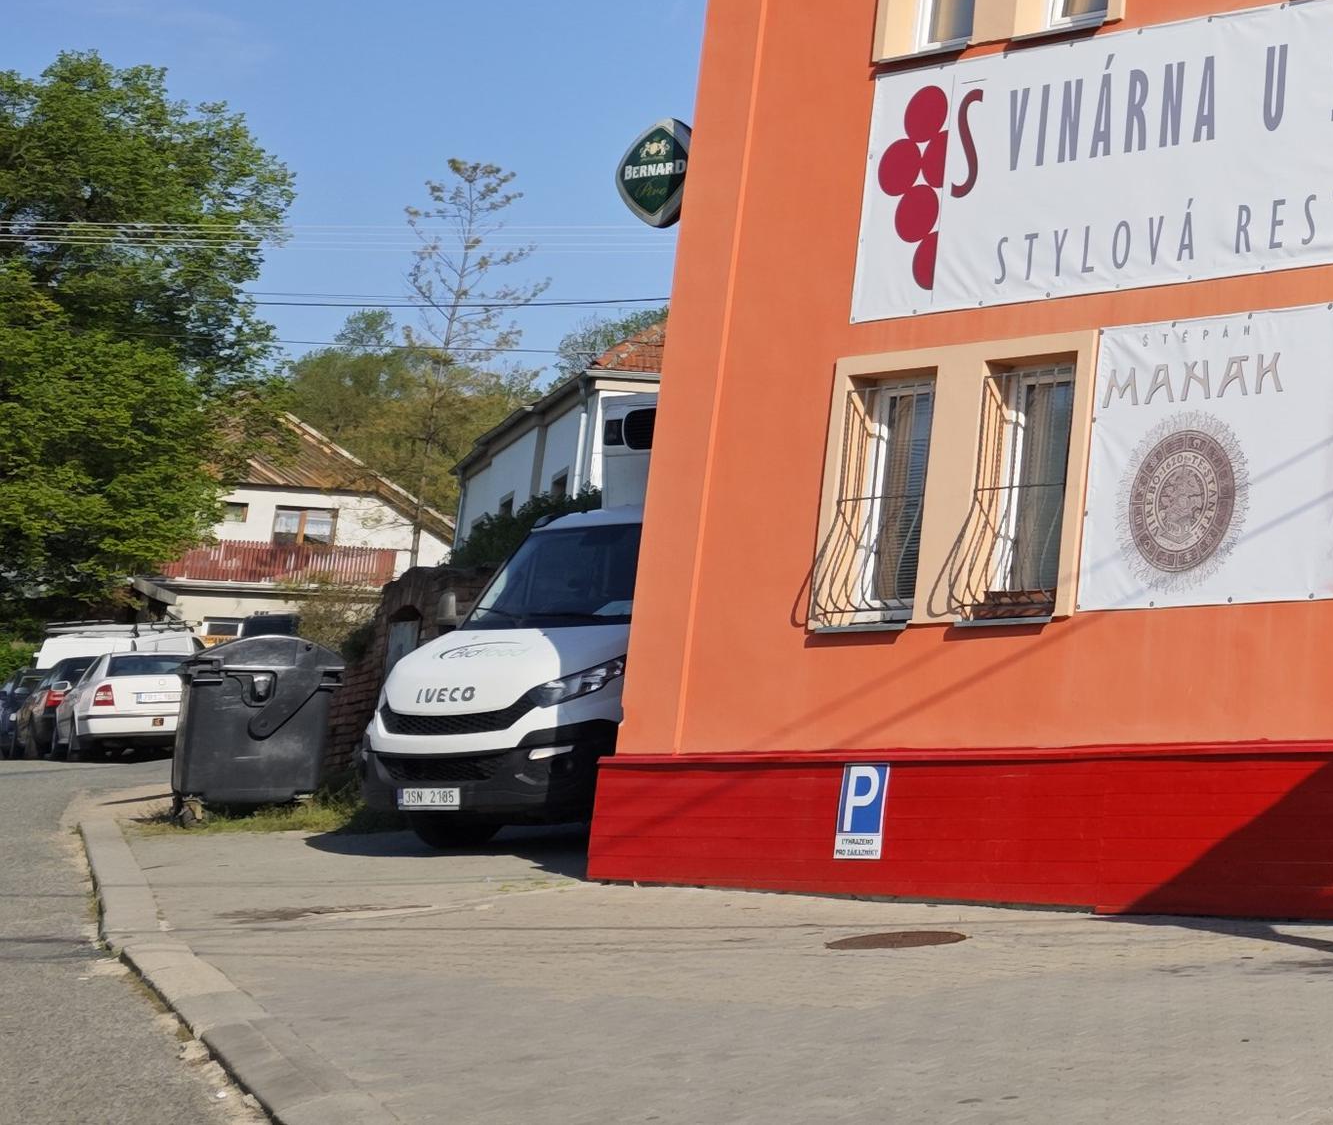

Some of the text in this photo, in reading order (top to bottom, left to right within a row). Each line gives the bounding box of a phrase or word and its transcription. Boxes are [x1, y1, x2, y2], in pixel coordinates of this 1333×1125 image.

[1009, 53, 1215, 171] VINÁRNA
[1263, 44, 1288, 131] U
[624, 159, 687, 180] BERNARD
[994, 198, 1194, 284] STYLOVÁ
[416, 686, 476, 704] IVECO
[843, 766, 880, 831] P
